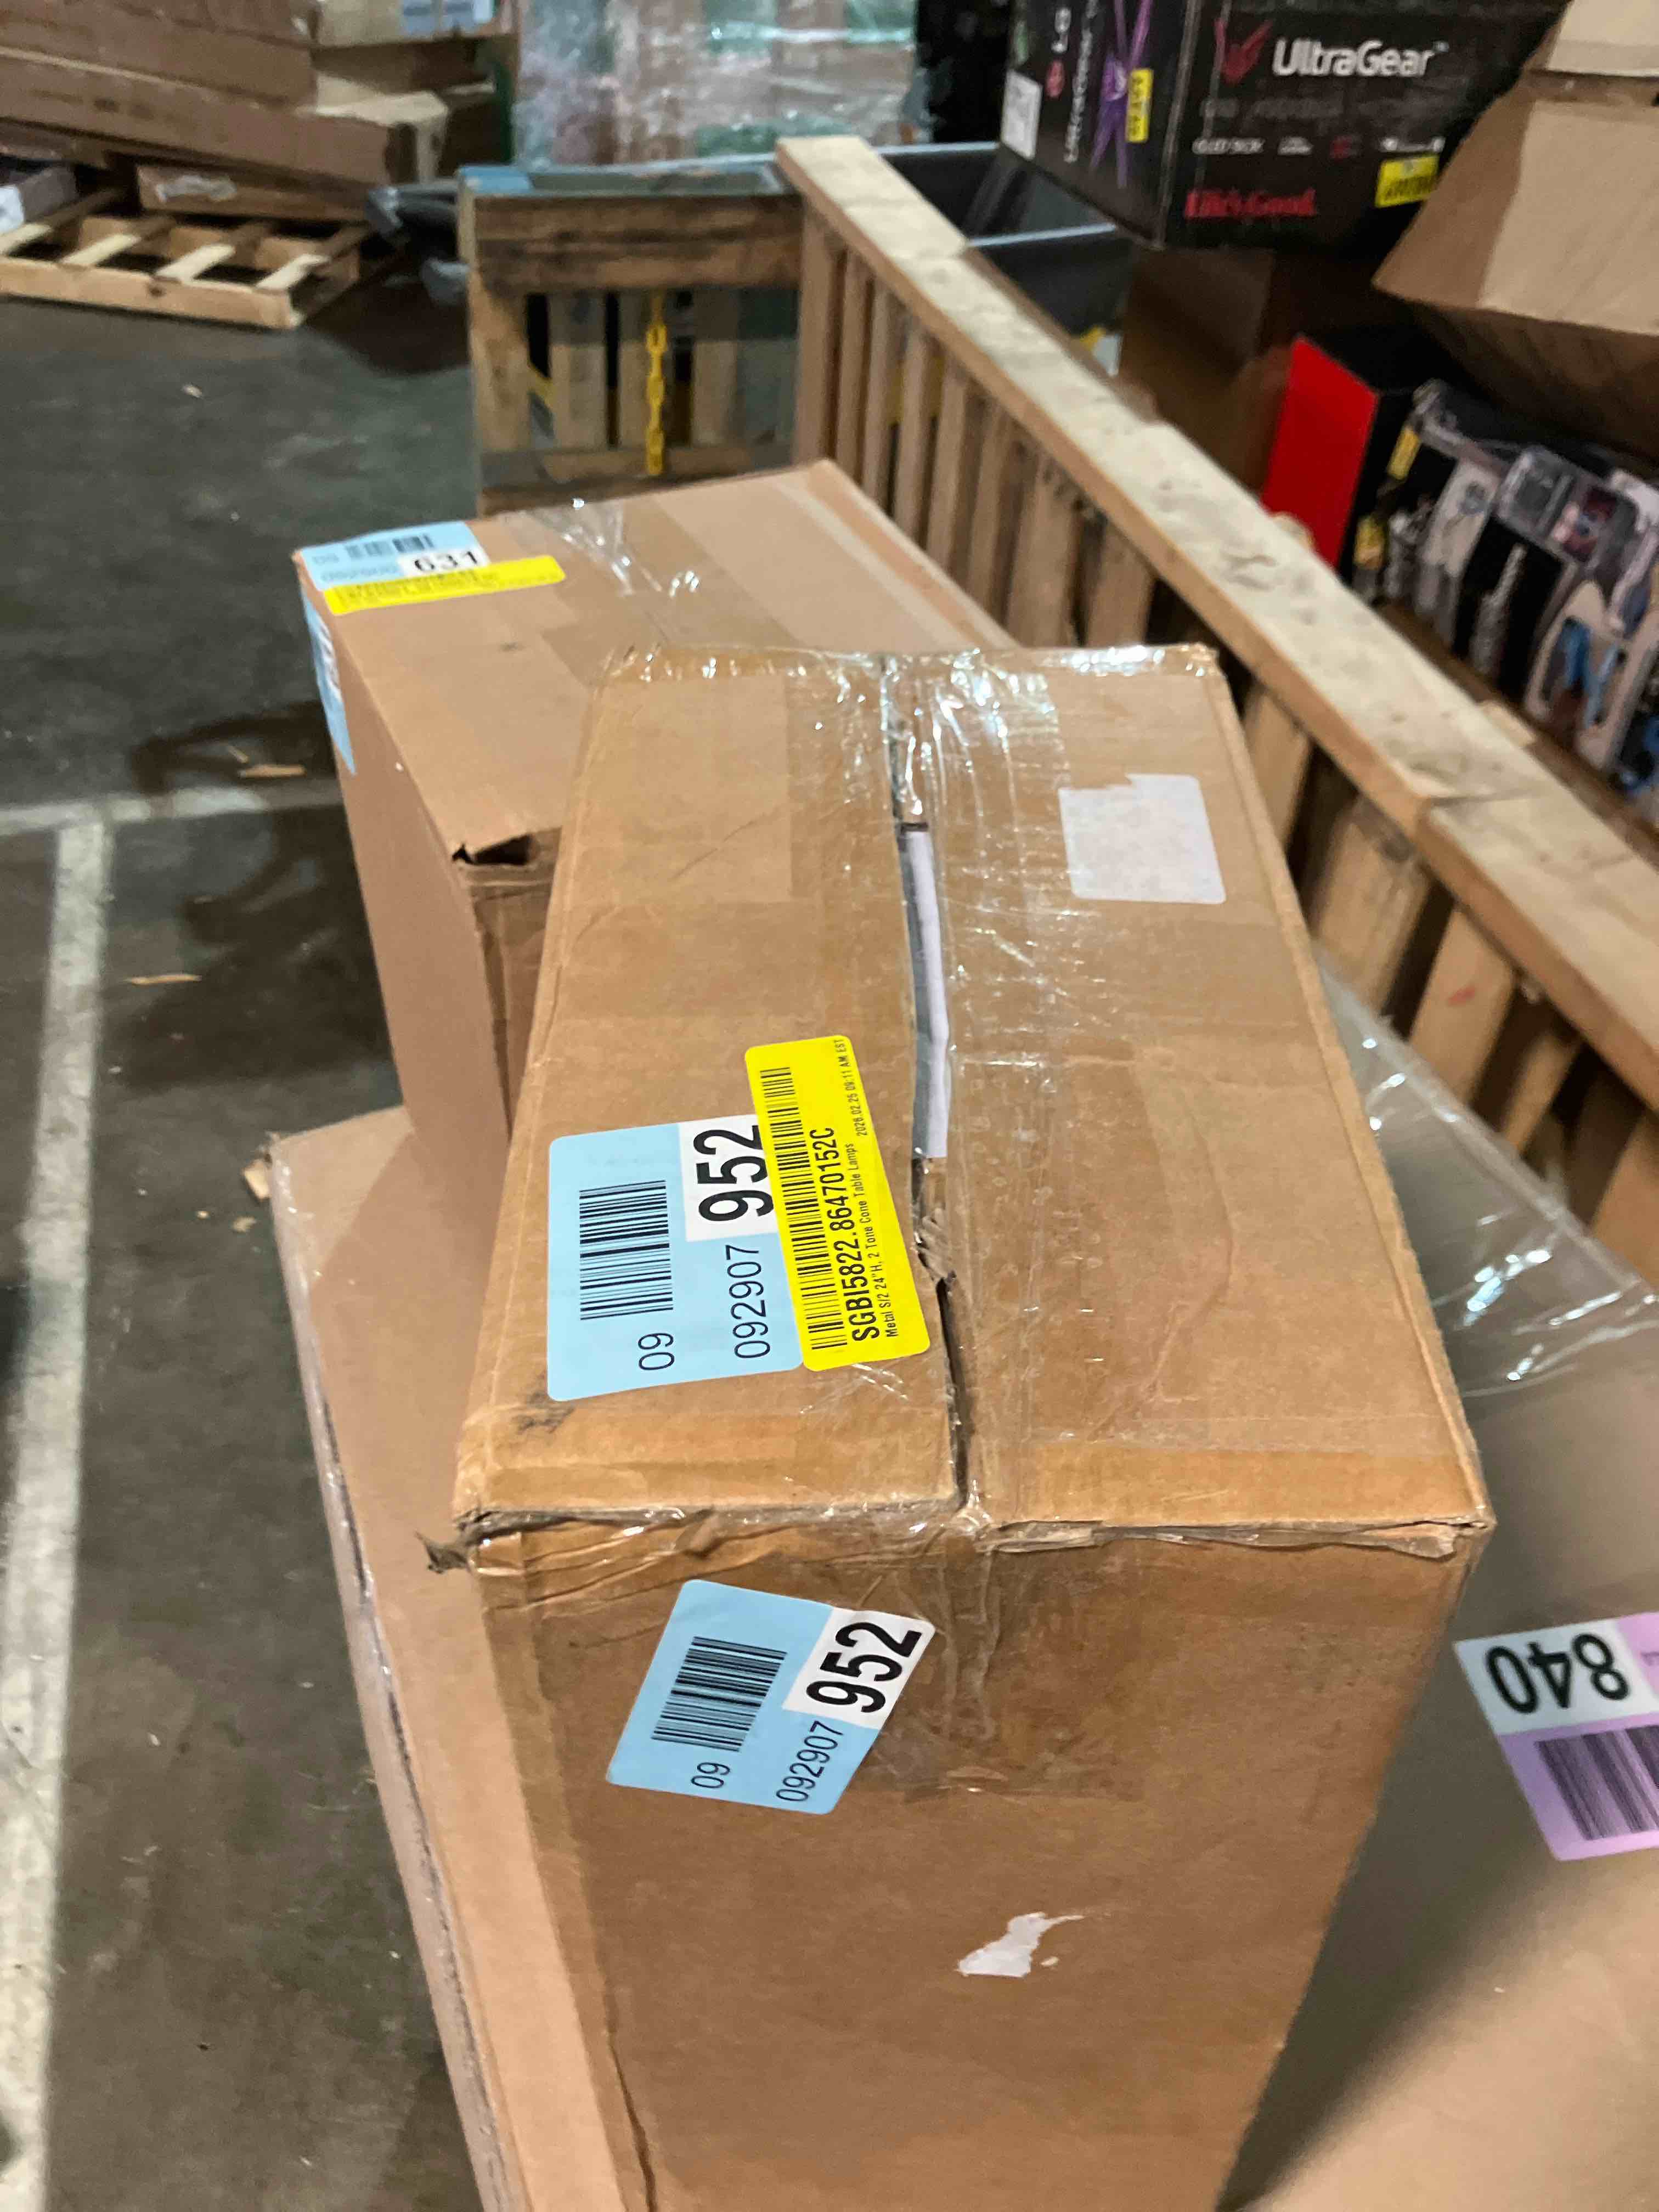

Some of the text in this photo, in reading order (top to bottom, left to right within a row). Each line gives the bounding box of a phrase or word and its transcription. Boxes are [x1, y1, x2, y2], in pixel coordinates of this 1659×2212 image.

[1272, 37, 1435, 77] UltraGear
[833, 1039, 847, 1052] EST
[838, 1055, 850, 1067] AM
[845, 1143, 859, 1171] Lamps
[693, 1125, 774, 1222] 952
[850, 1173, 865, 1197] Table
[859, 1200, 871, 1223] Cone
[809, 1127, 880, 1341] SGBI5822.86470152C
[865, 1226, 877, 1249] Tone
[725, 1244, 771, 1359] 092907
[877, 1293, 891, 1308] S/2
[881, 1311, 899, 1338] Metal
[637, 1332, 675, 1370] 09
[805, 1622, 922, 1713] 952
[1485, 1633, 1630, 1714] 840
[775, 1720, 844, 1802] 092907
[690, 1762, 731, 1789] 09
